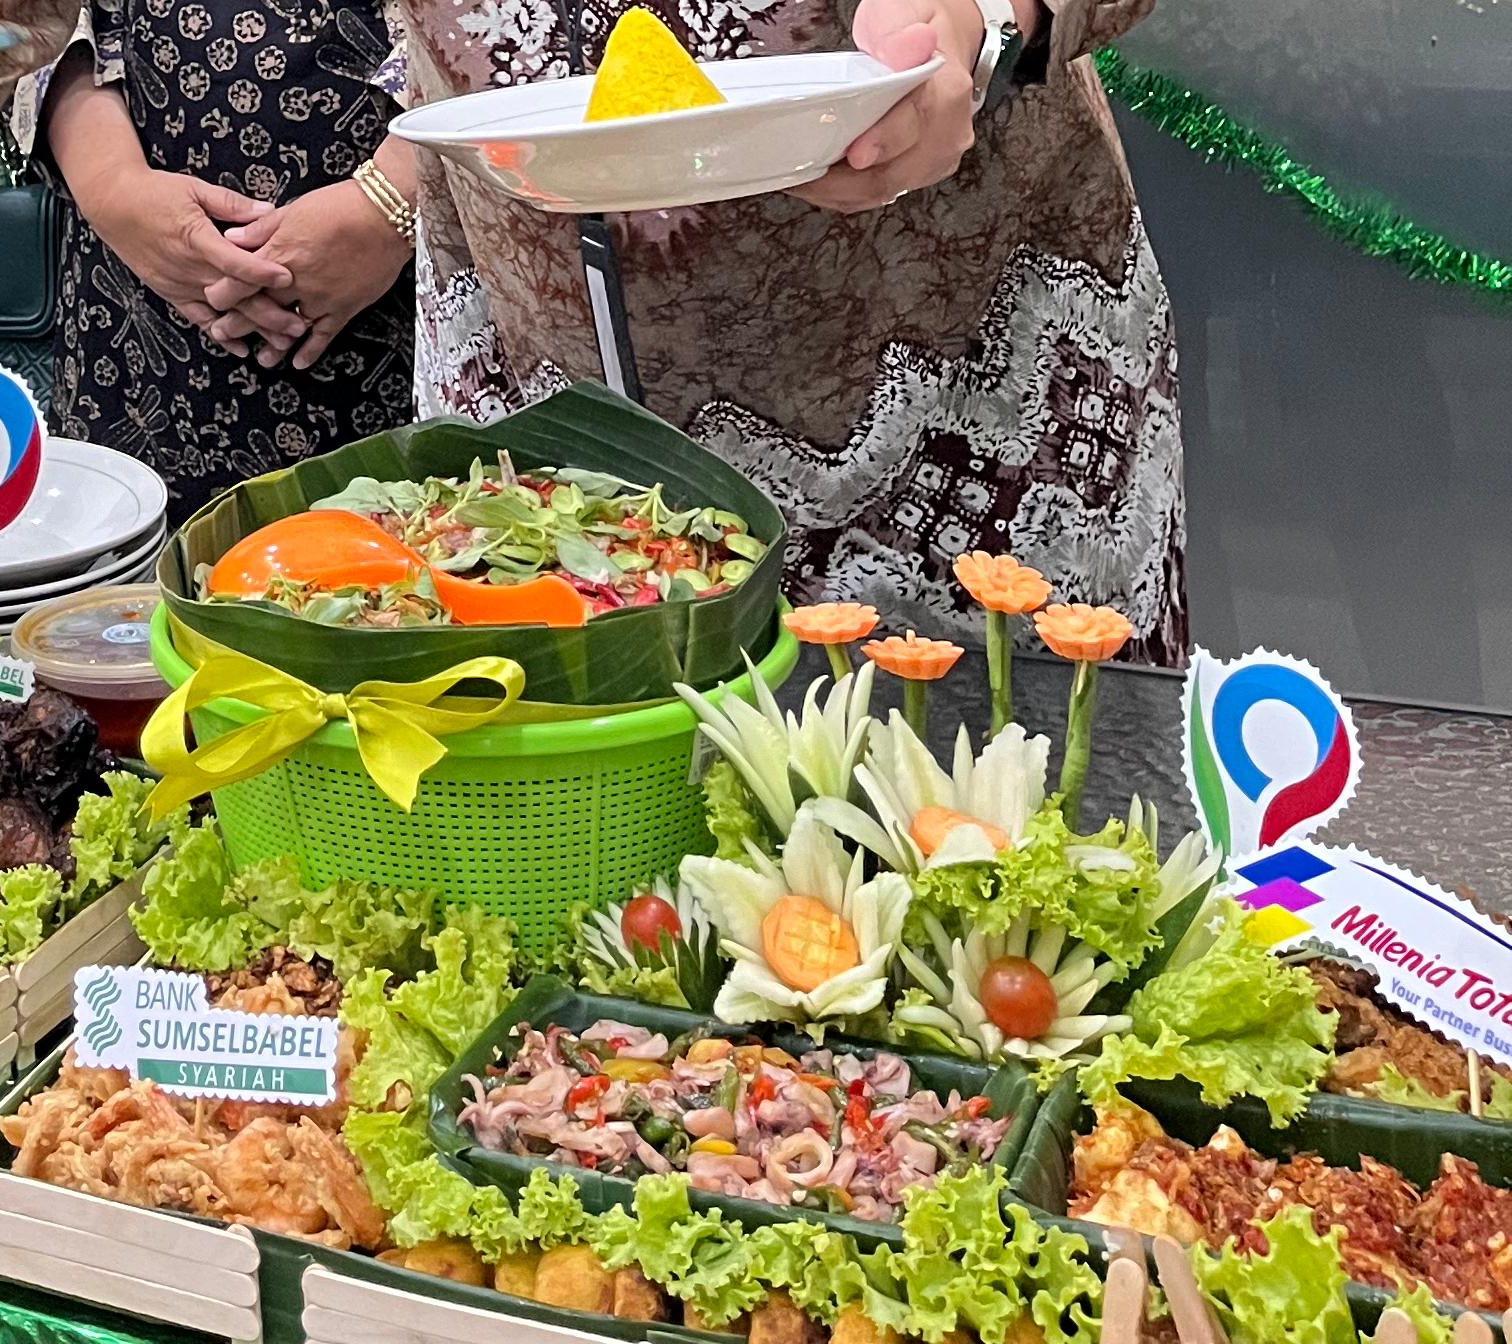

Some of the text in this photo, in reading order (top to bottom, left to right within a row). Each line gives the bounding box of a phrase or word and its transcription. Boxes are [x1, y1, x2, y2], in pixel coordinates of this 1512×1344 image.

[1330, 905, 1457, 988] Millenia
[135, 980, 200, 1012] BANK
[1390, 977, 1512, 1057] Your Partner Bus
[136, 1018, 327, 1058] SUMSELBABEL
[177, 1062, 285, 1091] SYARIAH
